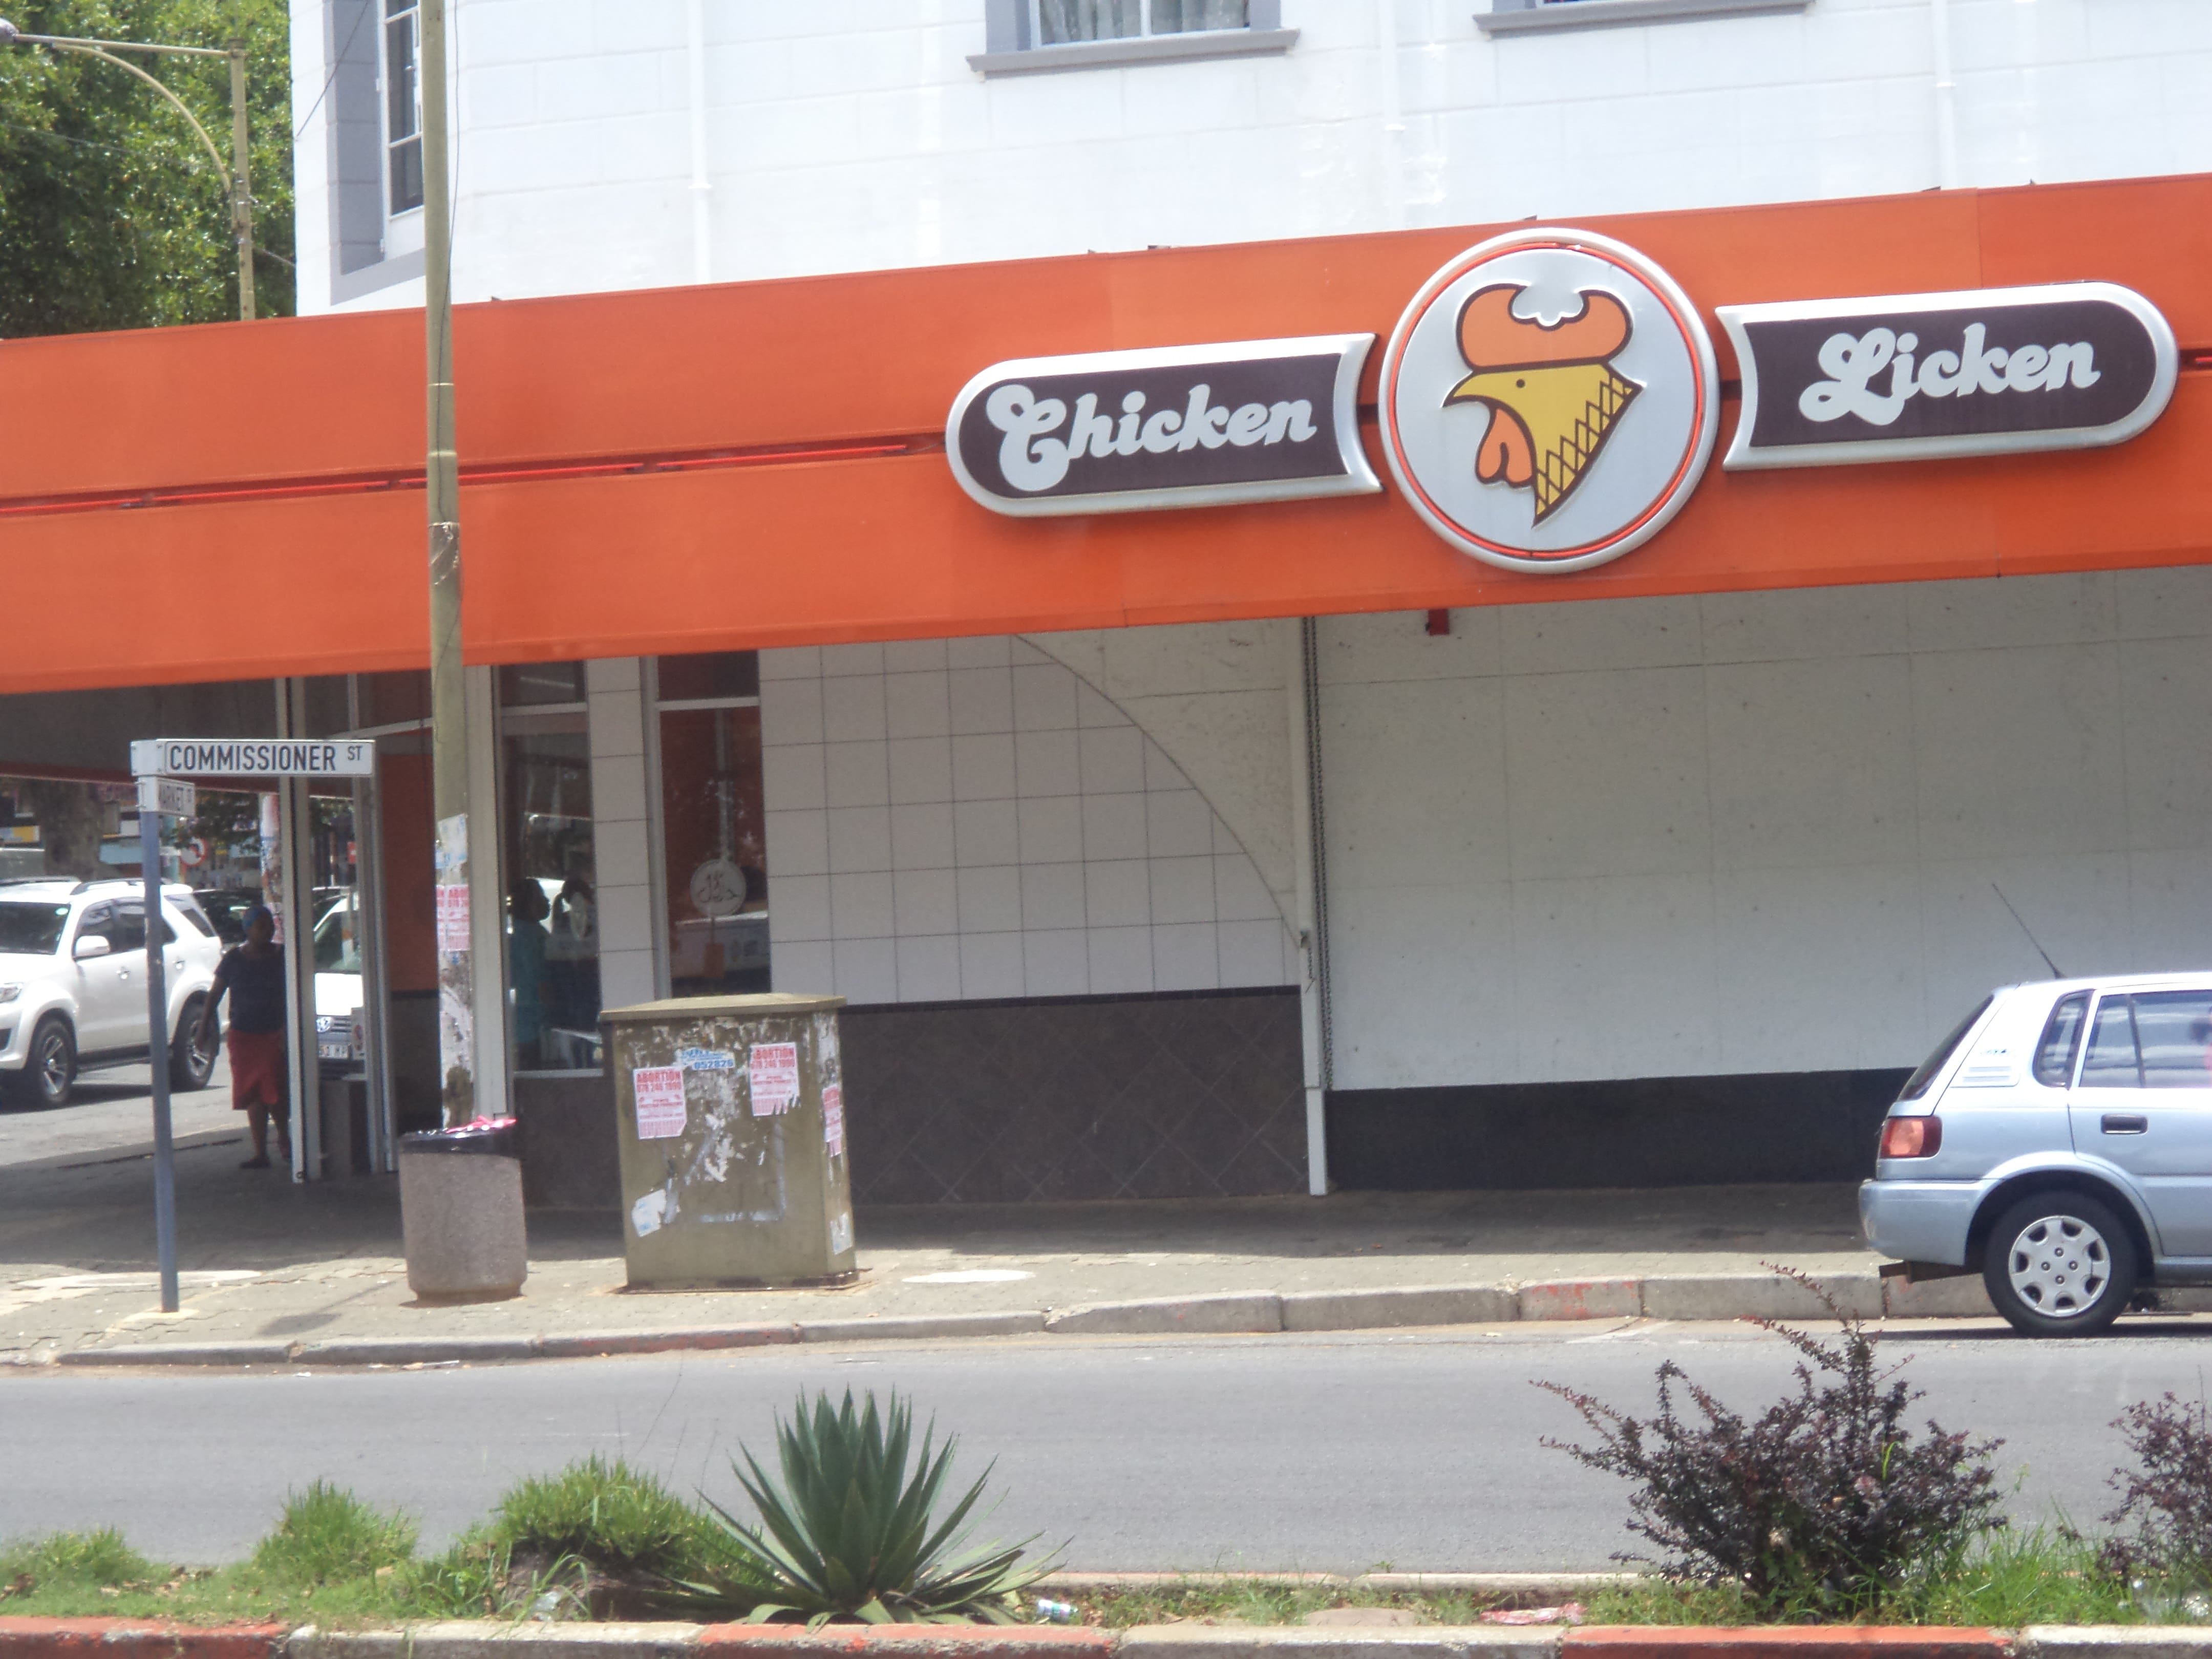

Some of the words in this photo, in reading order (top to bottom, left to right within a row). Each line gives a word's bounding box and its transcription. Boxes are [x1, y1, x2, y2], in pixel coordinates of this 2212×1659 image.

[1798, 322, 2101, 427] Licken
[985, 383, 1317, 492] Chicken
[170, 745, 336, 771] COMMISSIONER
[347, 746, 363, 761] ST
